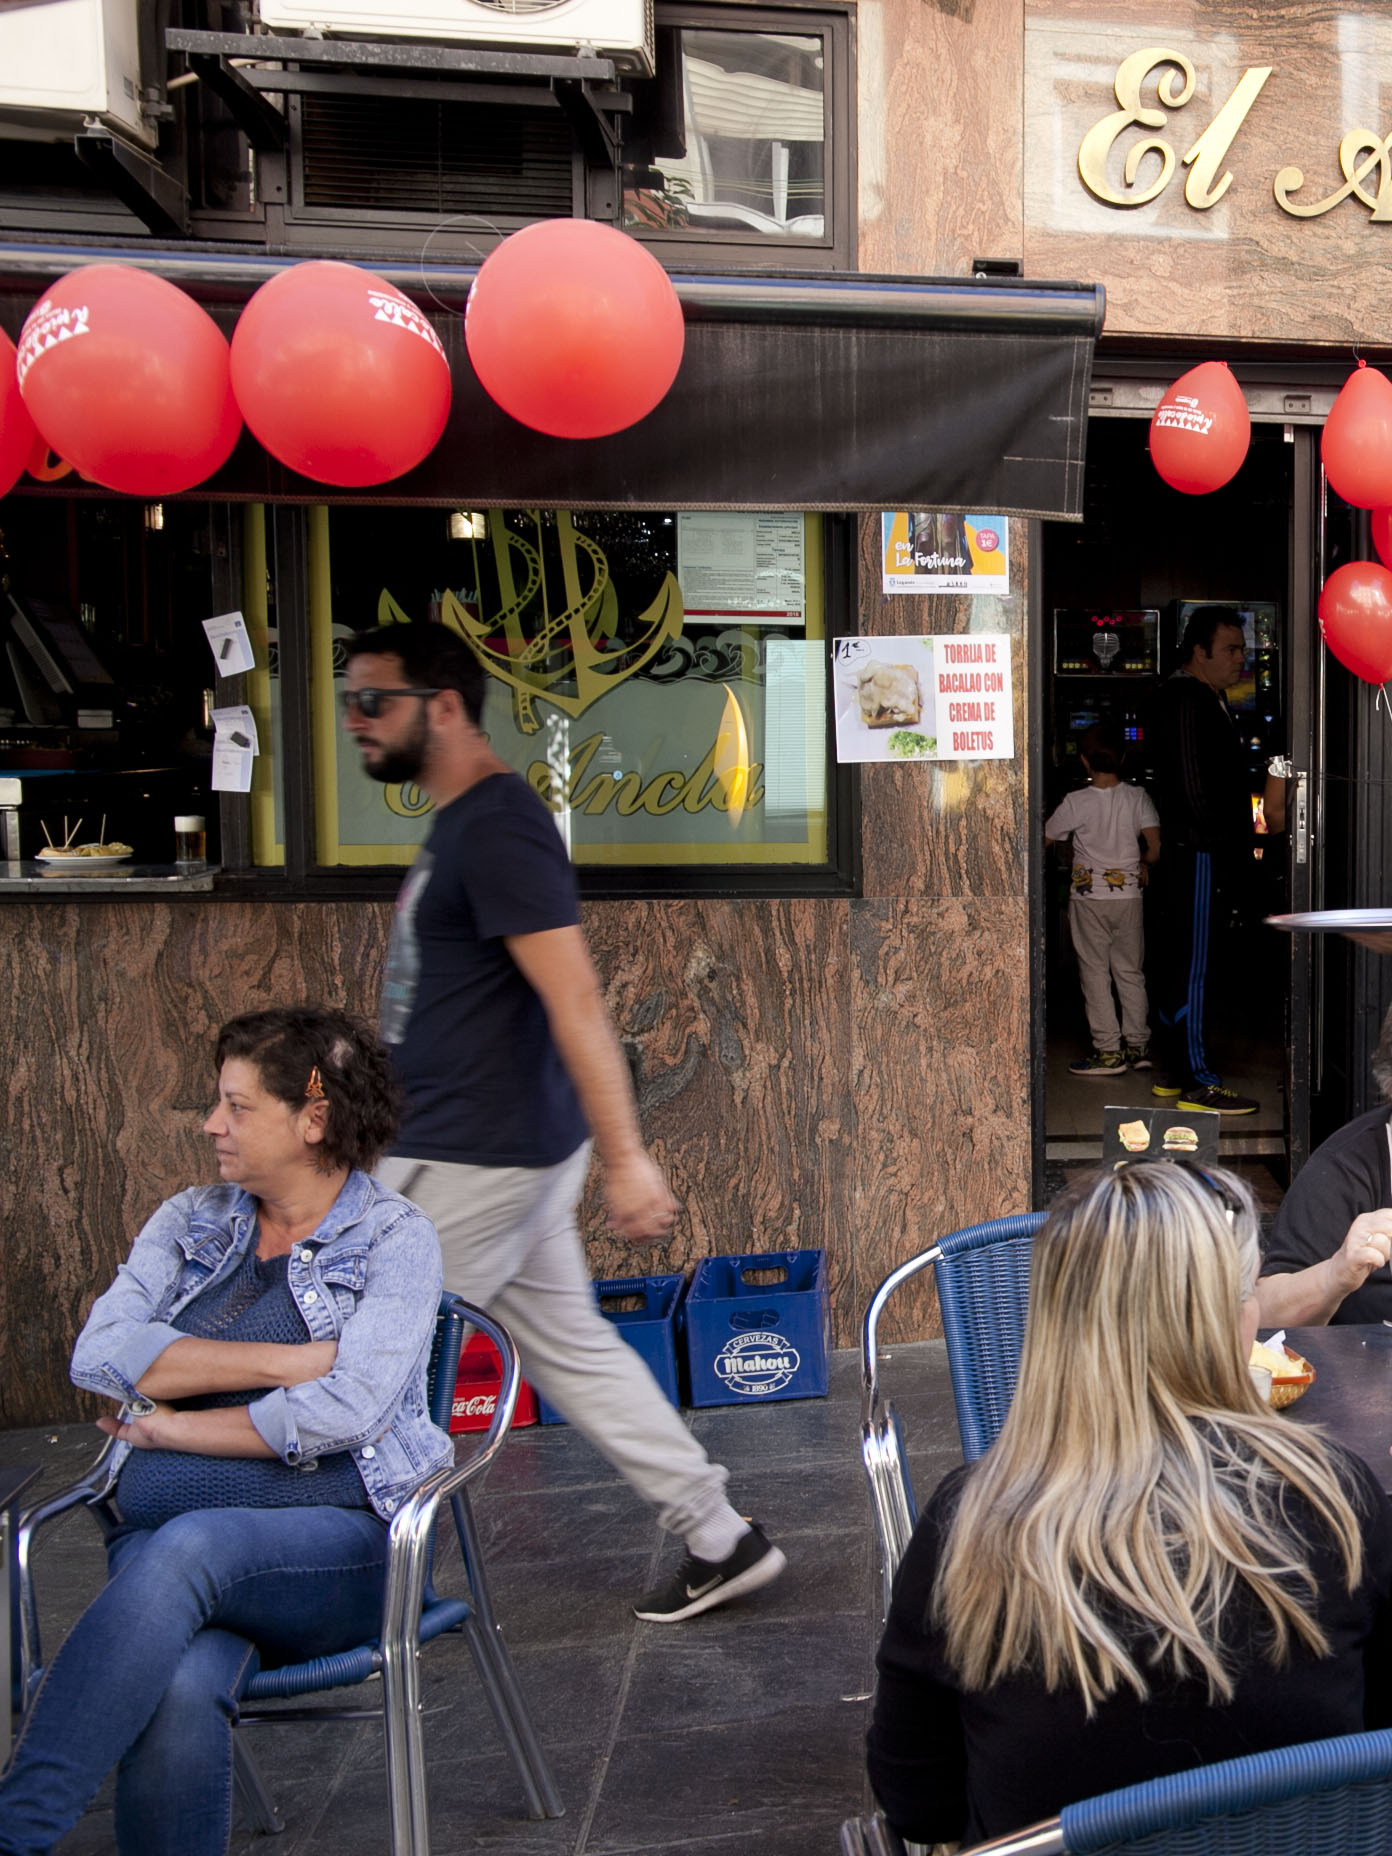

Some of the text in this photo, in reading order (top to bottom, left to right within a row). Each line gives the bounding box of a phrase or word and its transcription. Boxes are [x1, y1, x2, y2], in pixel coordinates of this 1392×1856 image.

[1079, 47, 1272, 209] El
[895, 541, 914, 553] en
[981, 539, 993, 548] 1€
[895, 552, 966, 569] La Fortuna
[944, 643, 997, 664] TORRIJA DE
[939, 672, 1003, 693] BACALAO CON
[949, 702, 996, 722] CREMA DE
[953, 731, 993, 751] BOLETUS
[731, 1333, 780, 1348] CERVEZAS
[724, 1356, 789, 1375] Mahou
[750, 1384, 769, 1394] 1890
[452, 1394, 497, 1417] ca-Cola
